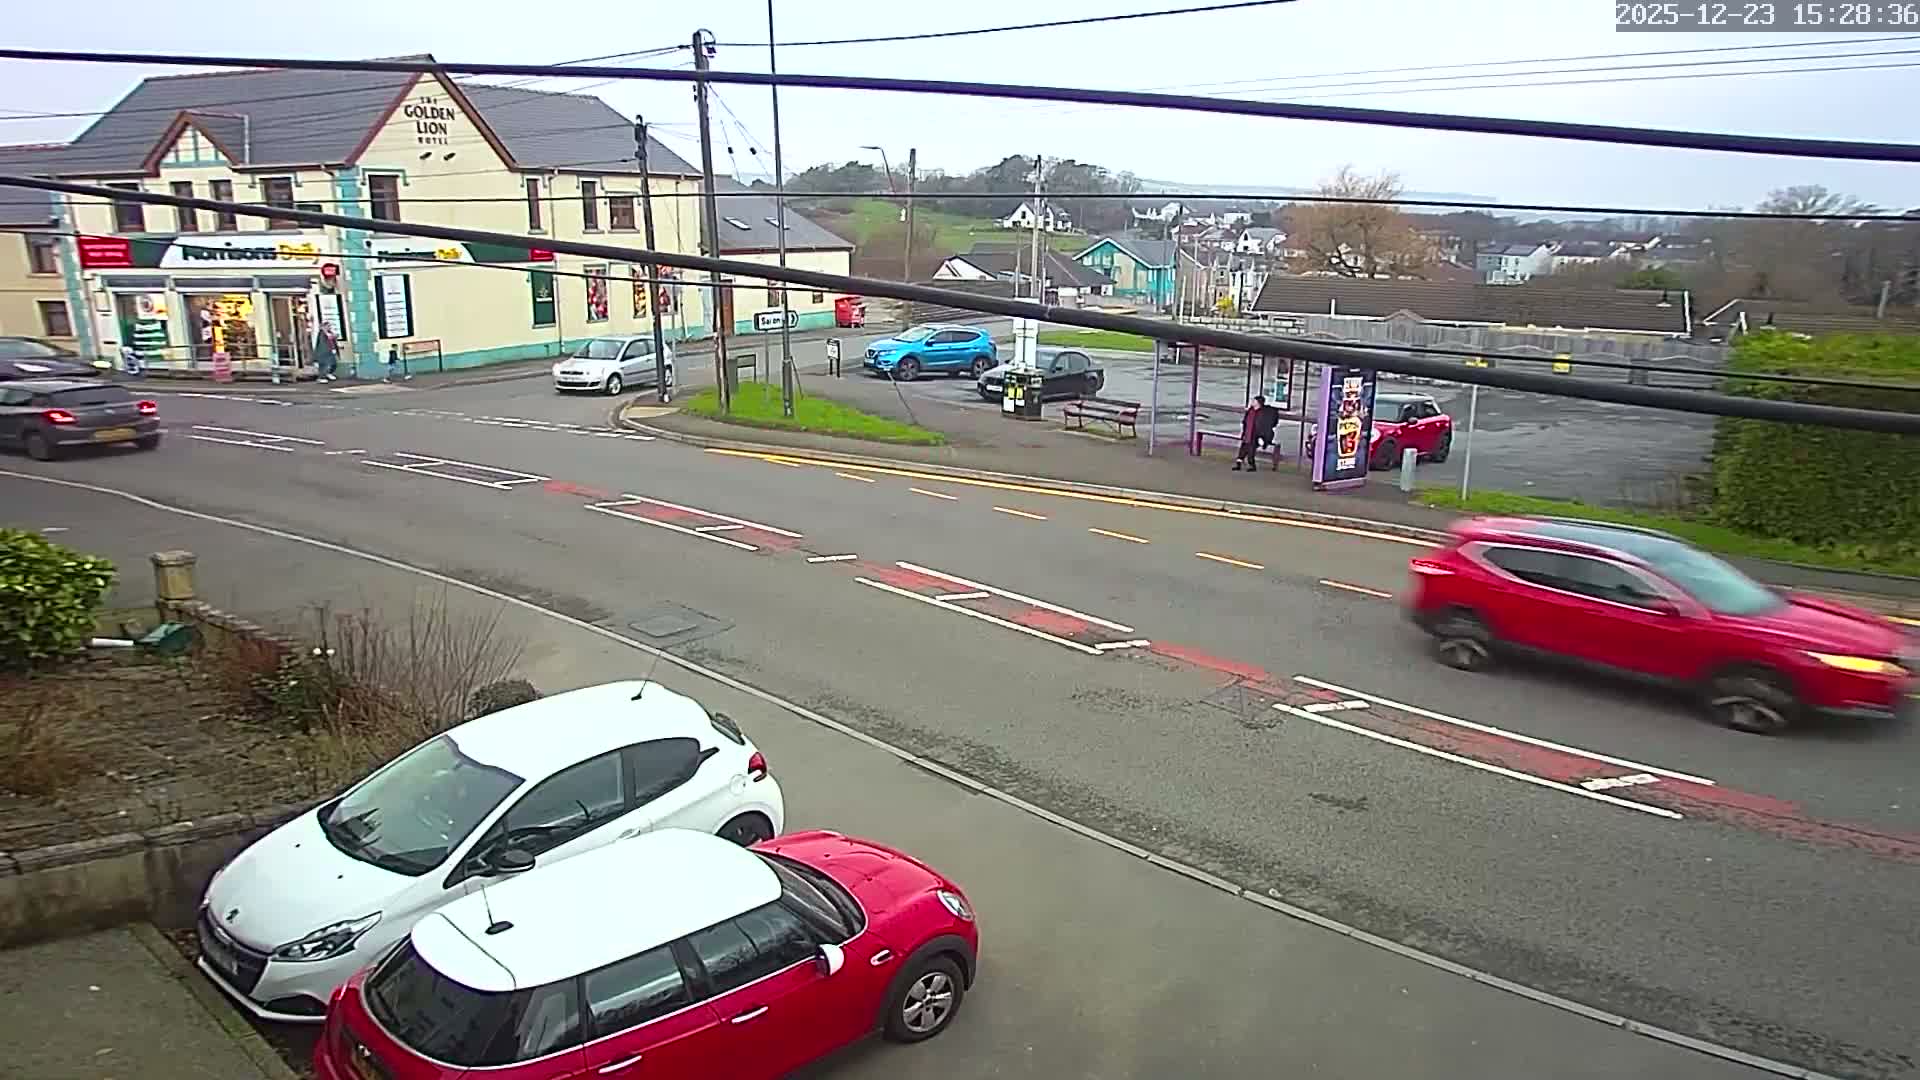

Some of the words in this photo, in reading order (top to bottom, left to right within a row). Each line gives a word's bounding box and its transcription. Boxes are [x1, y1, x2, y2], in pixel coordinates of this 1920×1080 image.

[404, 104, 455, 121] GOLDEN
[416, 120, 447, 135] LION
[417, 136, 448, 145] HOTEL
